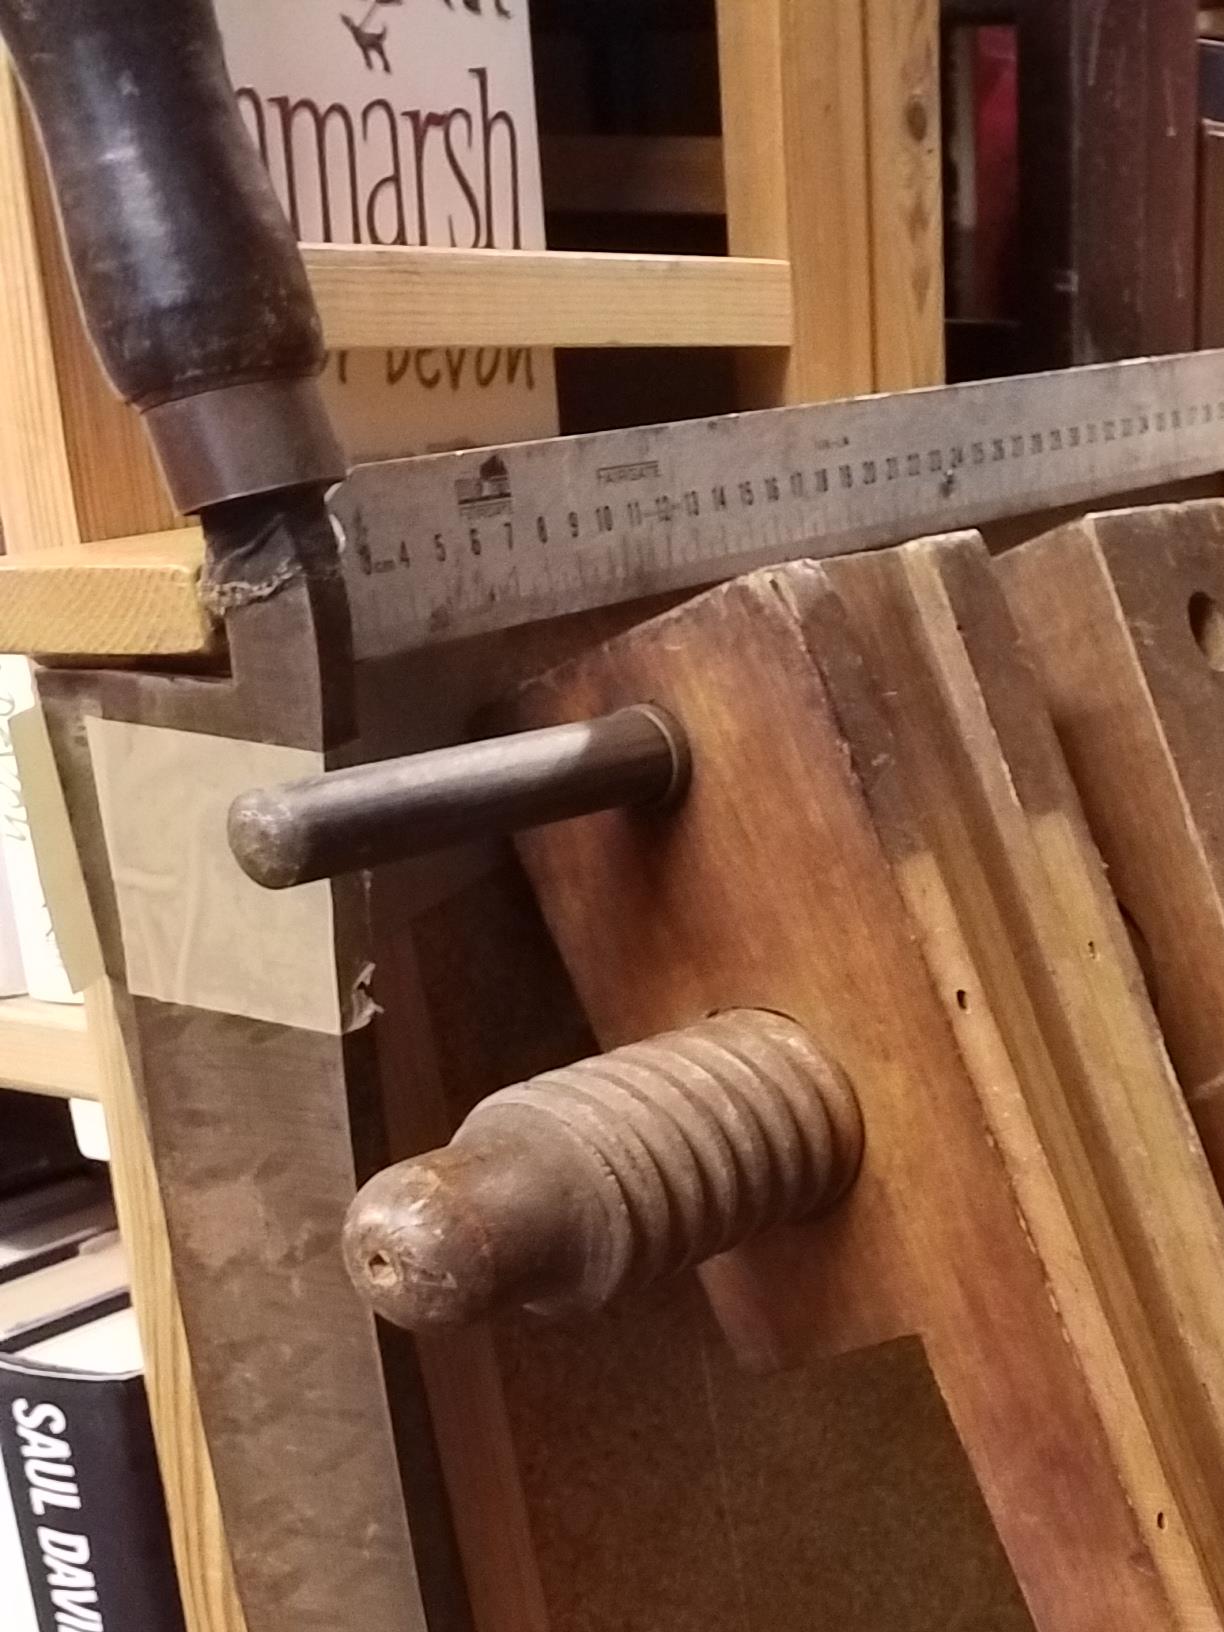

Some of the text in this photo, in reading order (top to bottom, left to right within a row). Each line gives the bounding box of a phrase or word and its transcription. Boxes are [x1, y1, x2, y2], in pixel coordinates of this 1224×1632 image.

[434, 533, 446, 562] 5
[469, 528, 482, 556] 6
[504, 522, 513, 550] 7
[567, 511, 579, 537] 9
[595, 505, 613, 531] 10
[12, 1397, 82, 1516] SAUL
